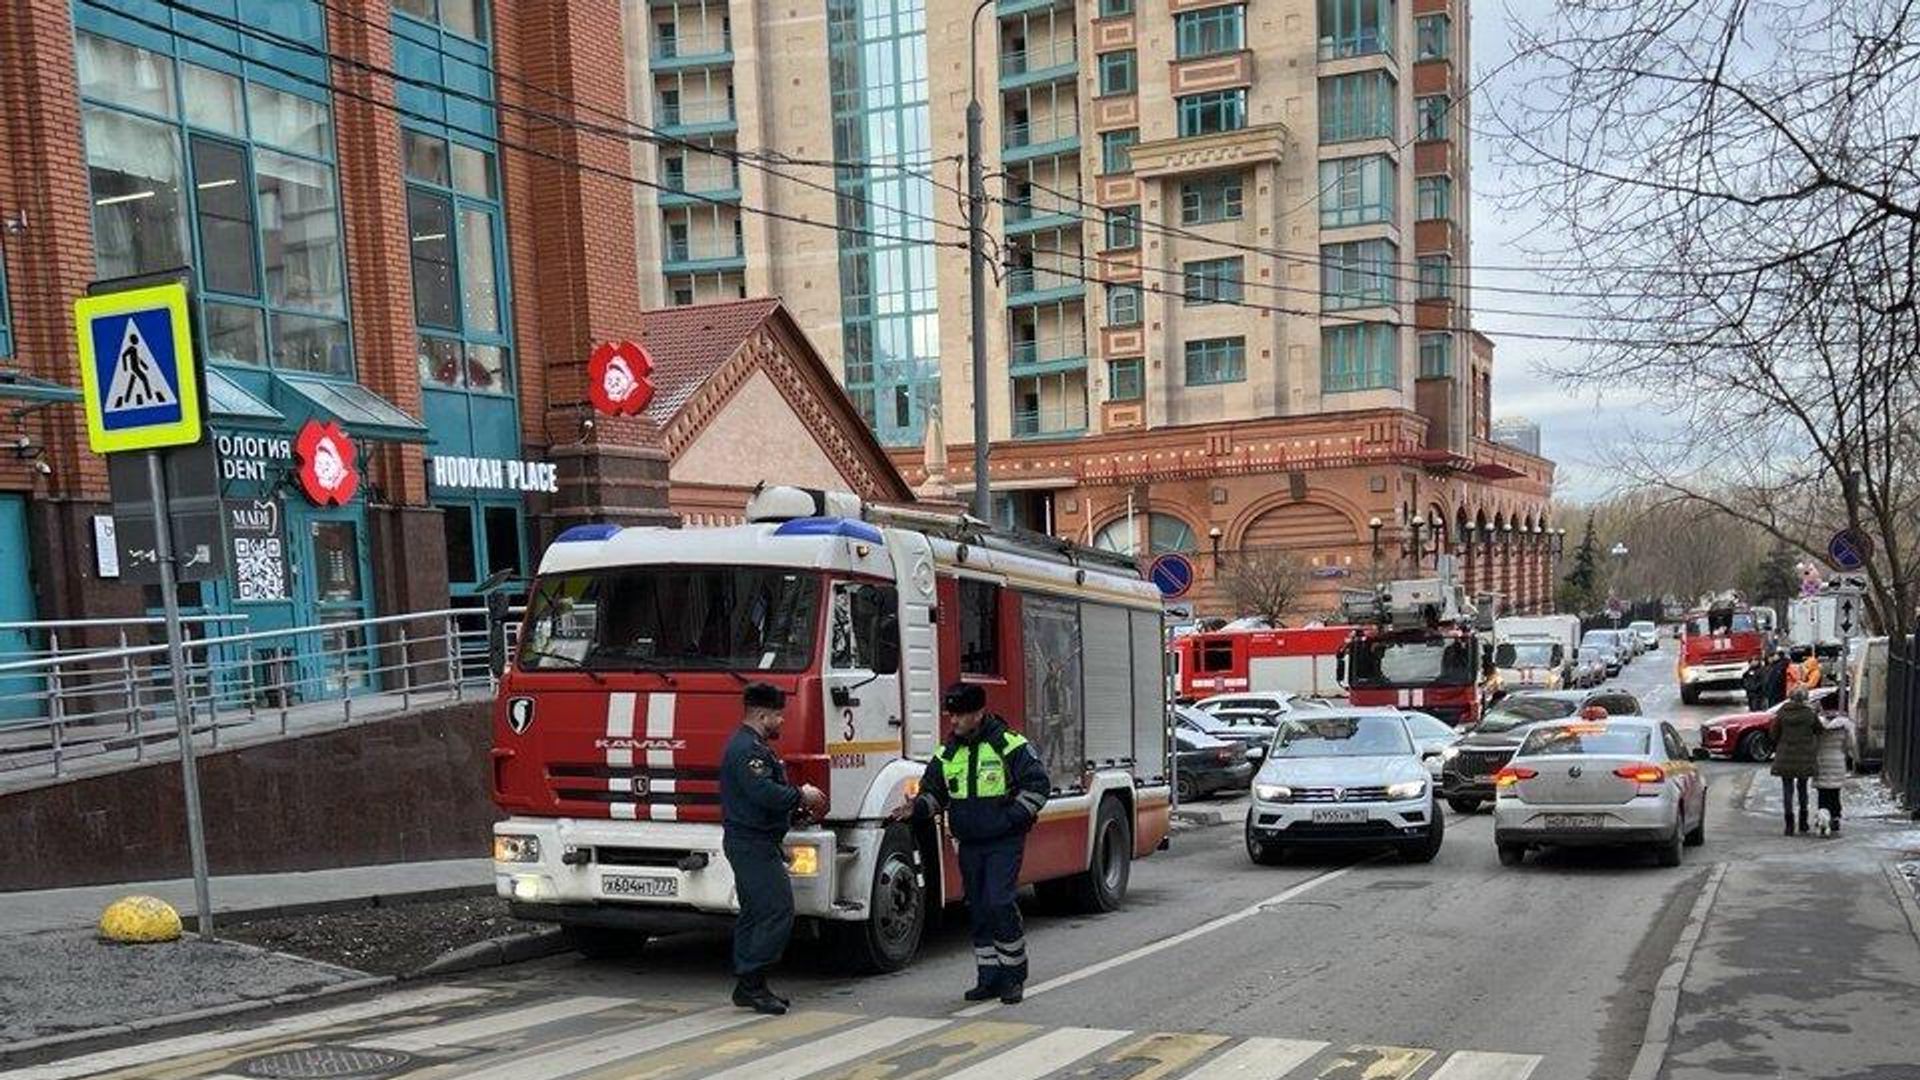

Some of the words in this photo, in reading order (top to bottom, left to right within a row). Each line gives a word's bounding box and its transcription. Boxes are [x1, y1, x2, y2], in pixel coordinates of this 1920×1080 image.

[213, 435, 291, 459] ОЛОГИЯ
[224, 459, 266, 480] DENT
[434, 456, 502, 488] HOOKAH
[507, 460, 558, 492] PLACE
[843, 709, 855, 741] 3
[595, 740, 687, 749] KAMAZ
[830, 753, 865, 769] МОСКВА
